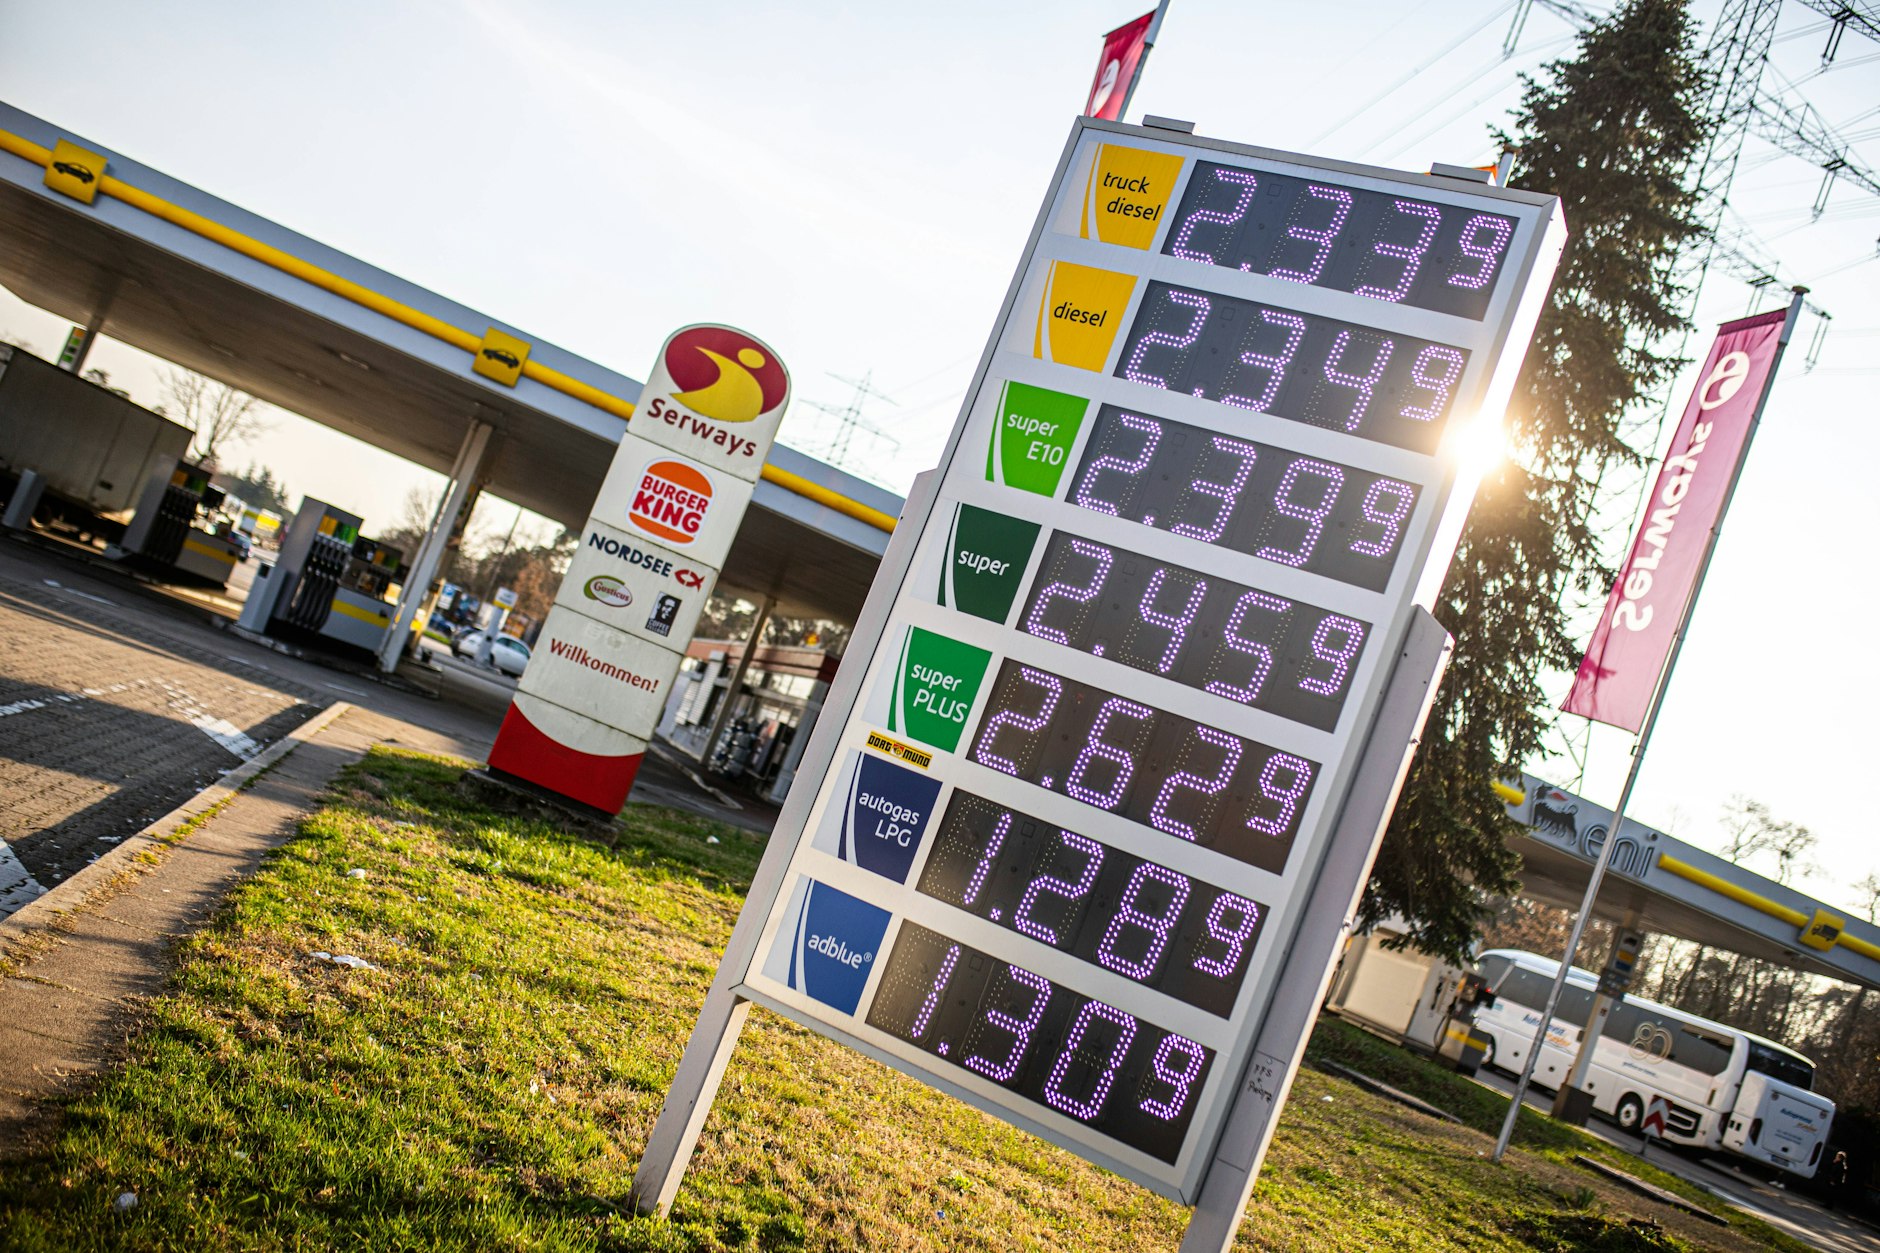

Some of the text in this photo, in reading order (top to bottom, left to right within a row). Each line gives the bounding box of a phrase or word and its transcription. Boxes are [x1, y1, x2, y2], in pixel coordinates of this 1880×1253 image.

[1103, 172, 1150, 194] truck
[1107, 197, 1161, 221] diesel
[1054, 302, 1107, 327] diesel
[646, 398, 757, 457] Serways
[1007, 413, 1059, 437] super
[1026, 440, 1064, 466] E10
[640, 475, 709, 514] BURGER
[632, 490, 703, 534] KING
[588, 532, 673, 578] NORDSEE
[957, 550, 1010, 576] super
[593, 581, 630, 602] Gusticus
[648, 619, 670, 632] COFFEE
[550, 638, 659, 693] Willkommen!
[911, 664, 962, 692] super
[913, 688, 968, 723] PLUS
[858, 792, 920, 826] autogas
[874, 819, 912, 847] LPG
[1582, 823, 1658, 878] eni
